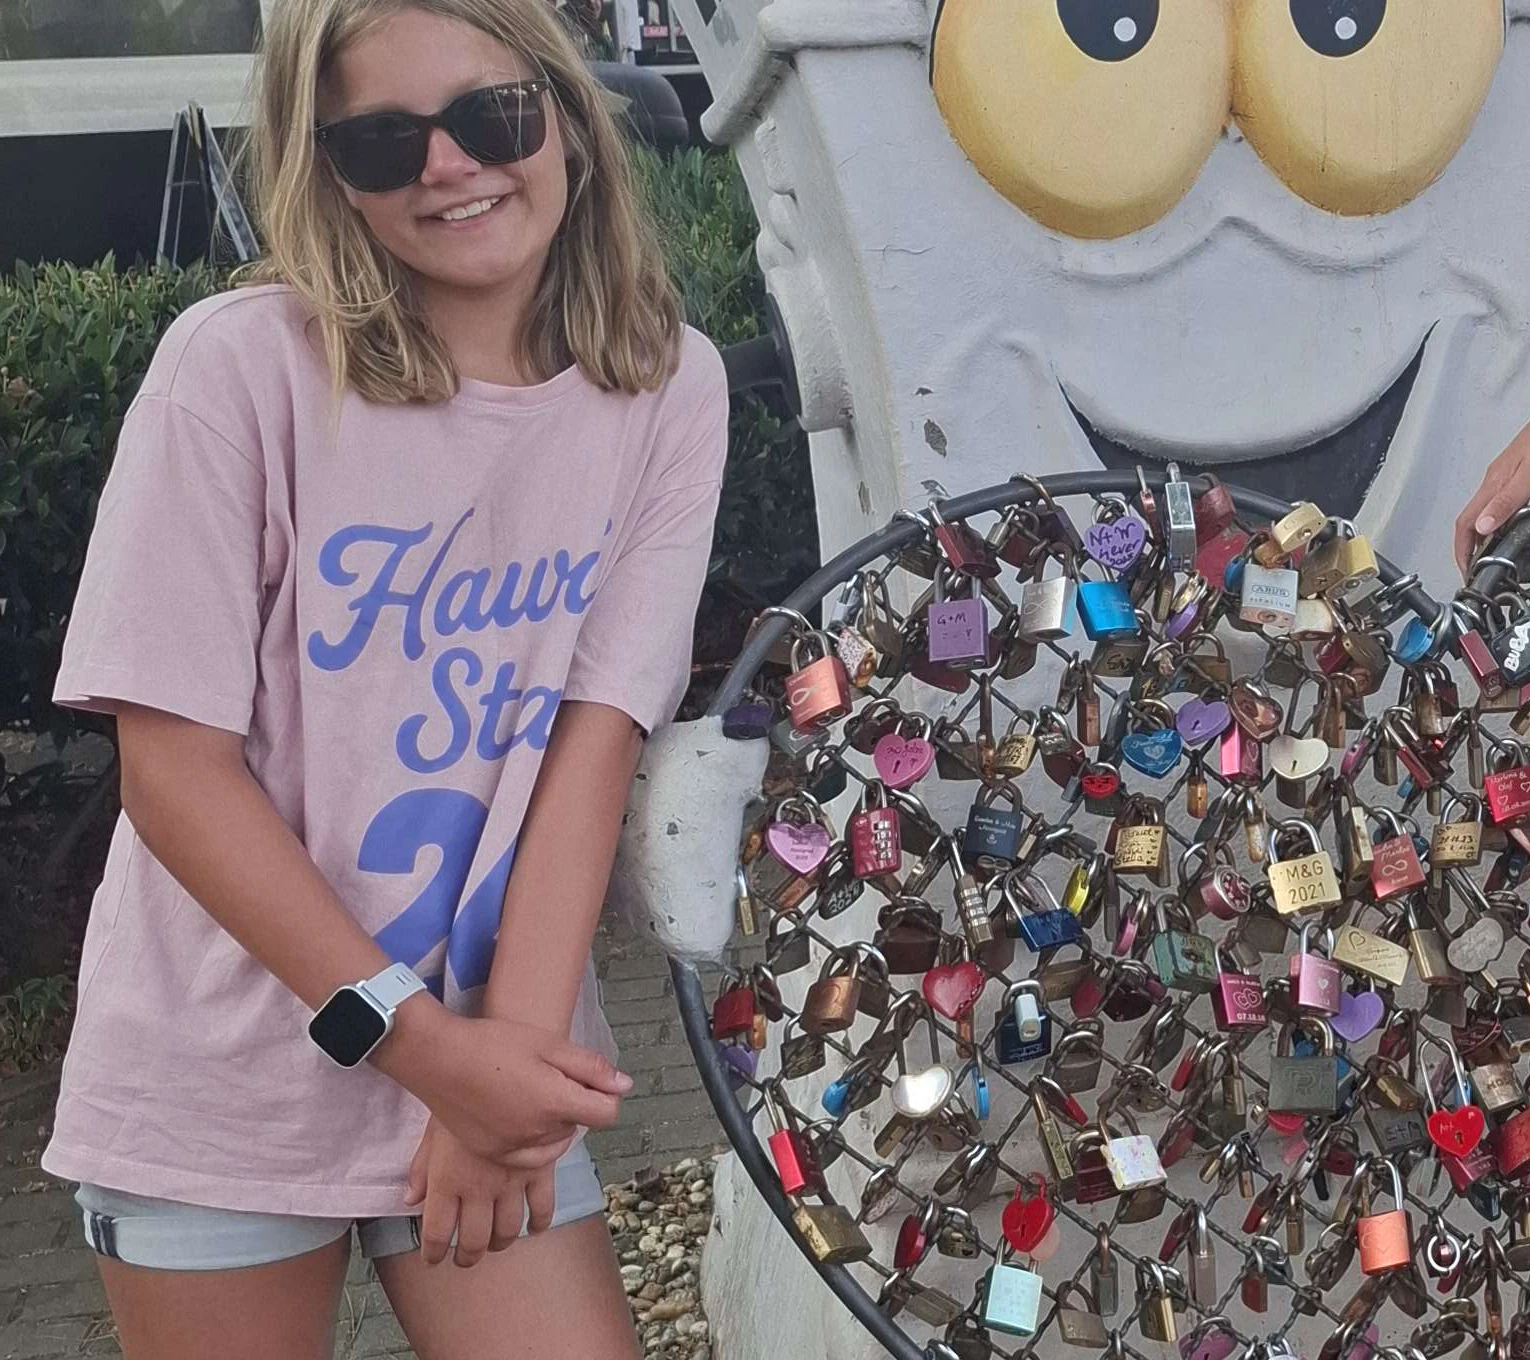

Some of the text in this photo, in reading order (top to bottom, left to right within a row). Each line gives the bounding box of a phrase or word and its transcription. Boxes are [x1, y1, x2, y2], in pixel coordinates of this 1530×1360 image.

[306, 506, 613, 672] Hawa
[1286, 865, 1324, 882] M&G
[1288, 888, 1327, 906] 2021
